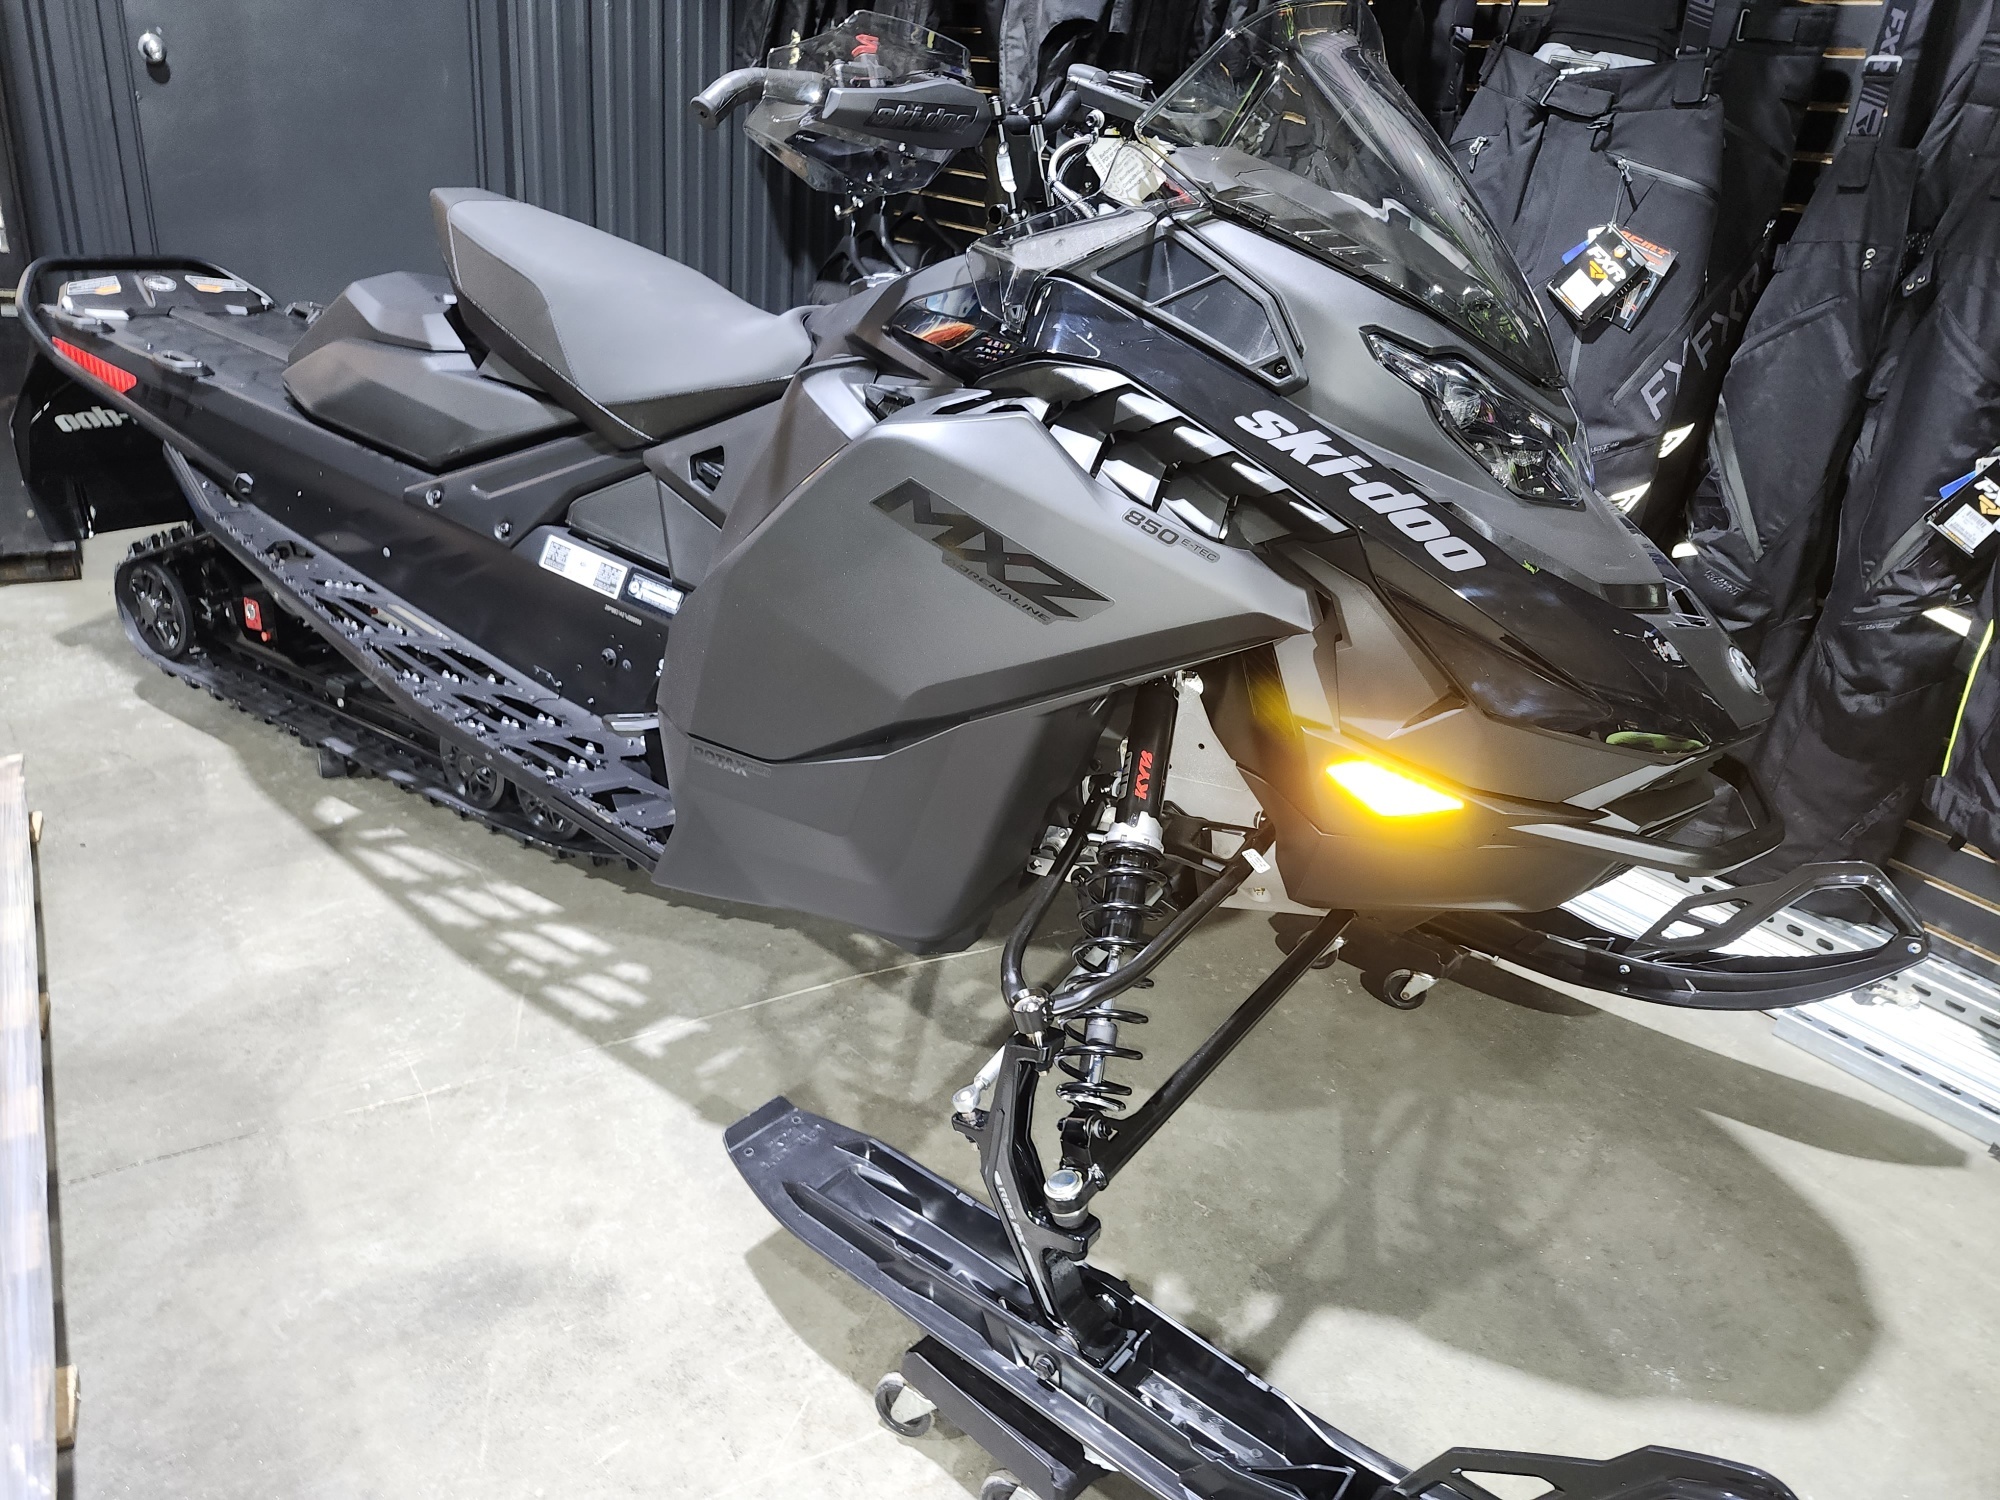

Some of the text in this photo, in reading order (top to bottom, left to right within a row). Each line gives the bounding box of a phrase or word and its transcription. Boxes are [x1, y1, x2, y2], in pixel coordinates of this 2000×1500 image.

[1586, 243, 1627, 283] FXR
[1640, 335, 1690, 421] FX
[1233, 409, 1487, 572] ski-doo
[871, 477, 1111, 618] MXZ
[1124, 510, 1217, 562] 850 E-TEC
[944, 556, 1051, 622] ADRENALINE
[1134, 750, 1153, 800] KYB
[998, 1187, 1017, 1220] RAS
